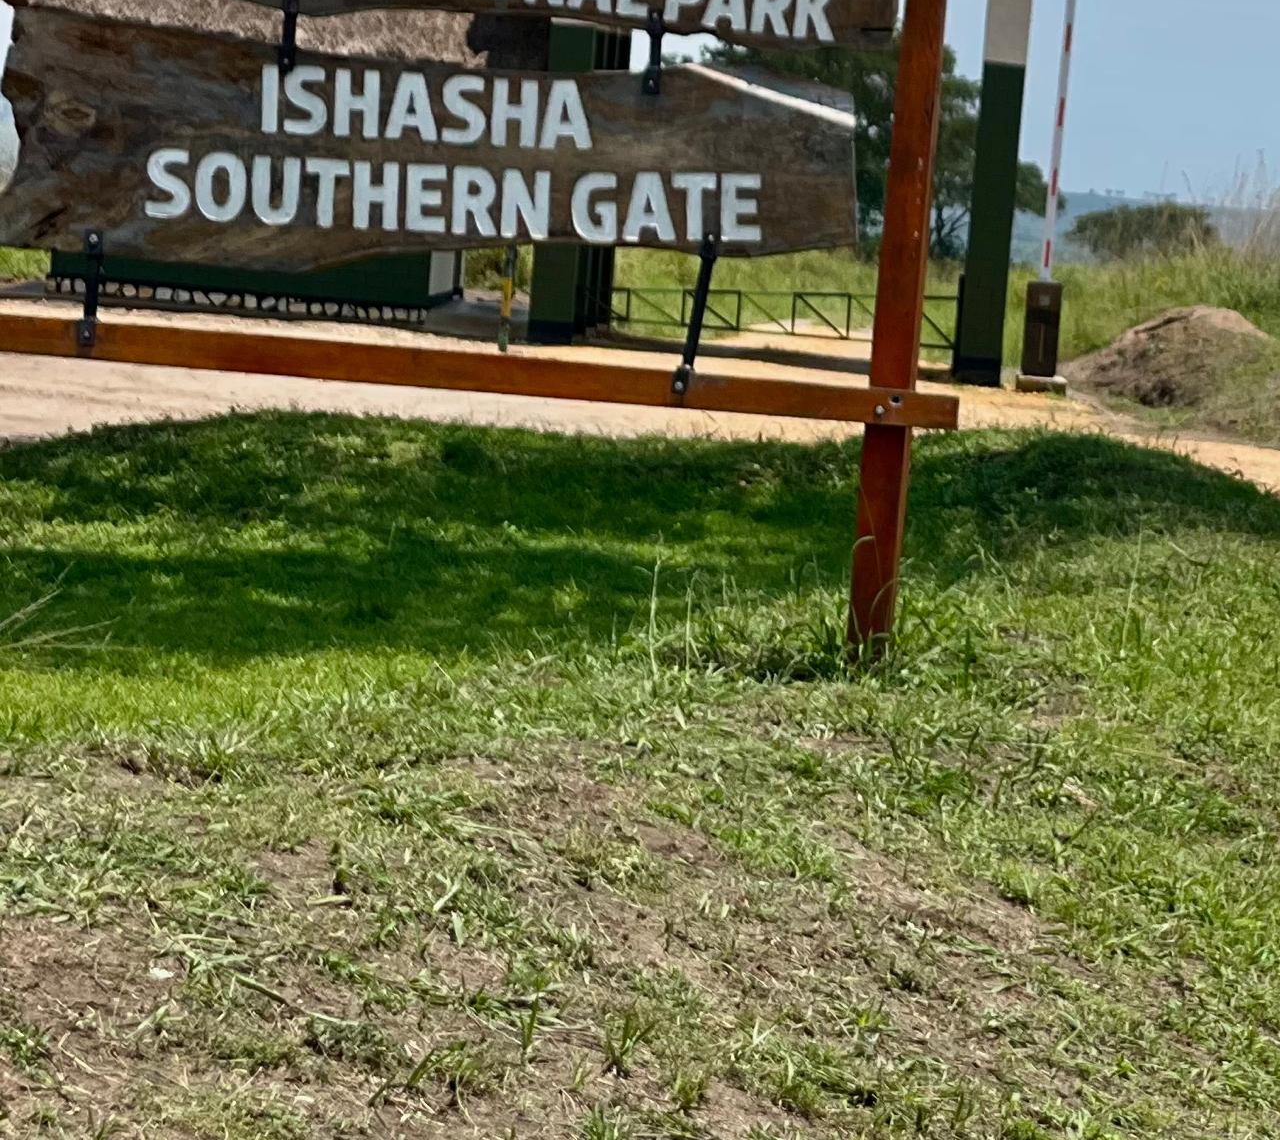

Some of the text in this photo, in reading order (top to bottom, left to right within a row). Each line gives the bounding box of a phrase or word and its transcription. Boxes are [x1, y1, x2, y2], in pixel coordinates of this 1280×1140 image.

[260, 63, 593, 150] ISHASHA
[144, 147, 763, 244] SOUTHERN GATE
